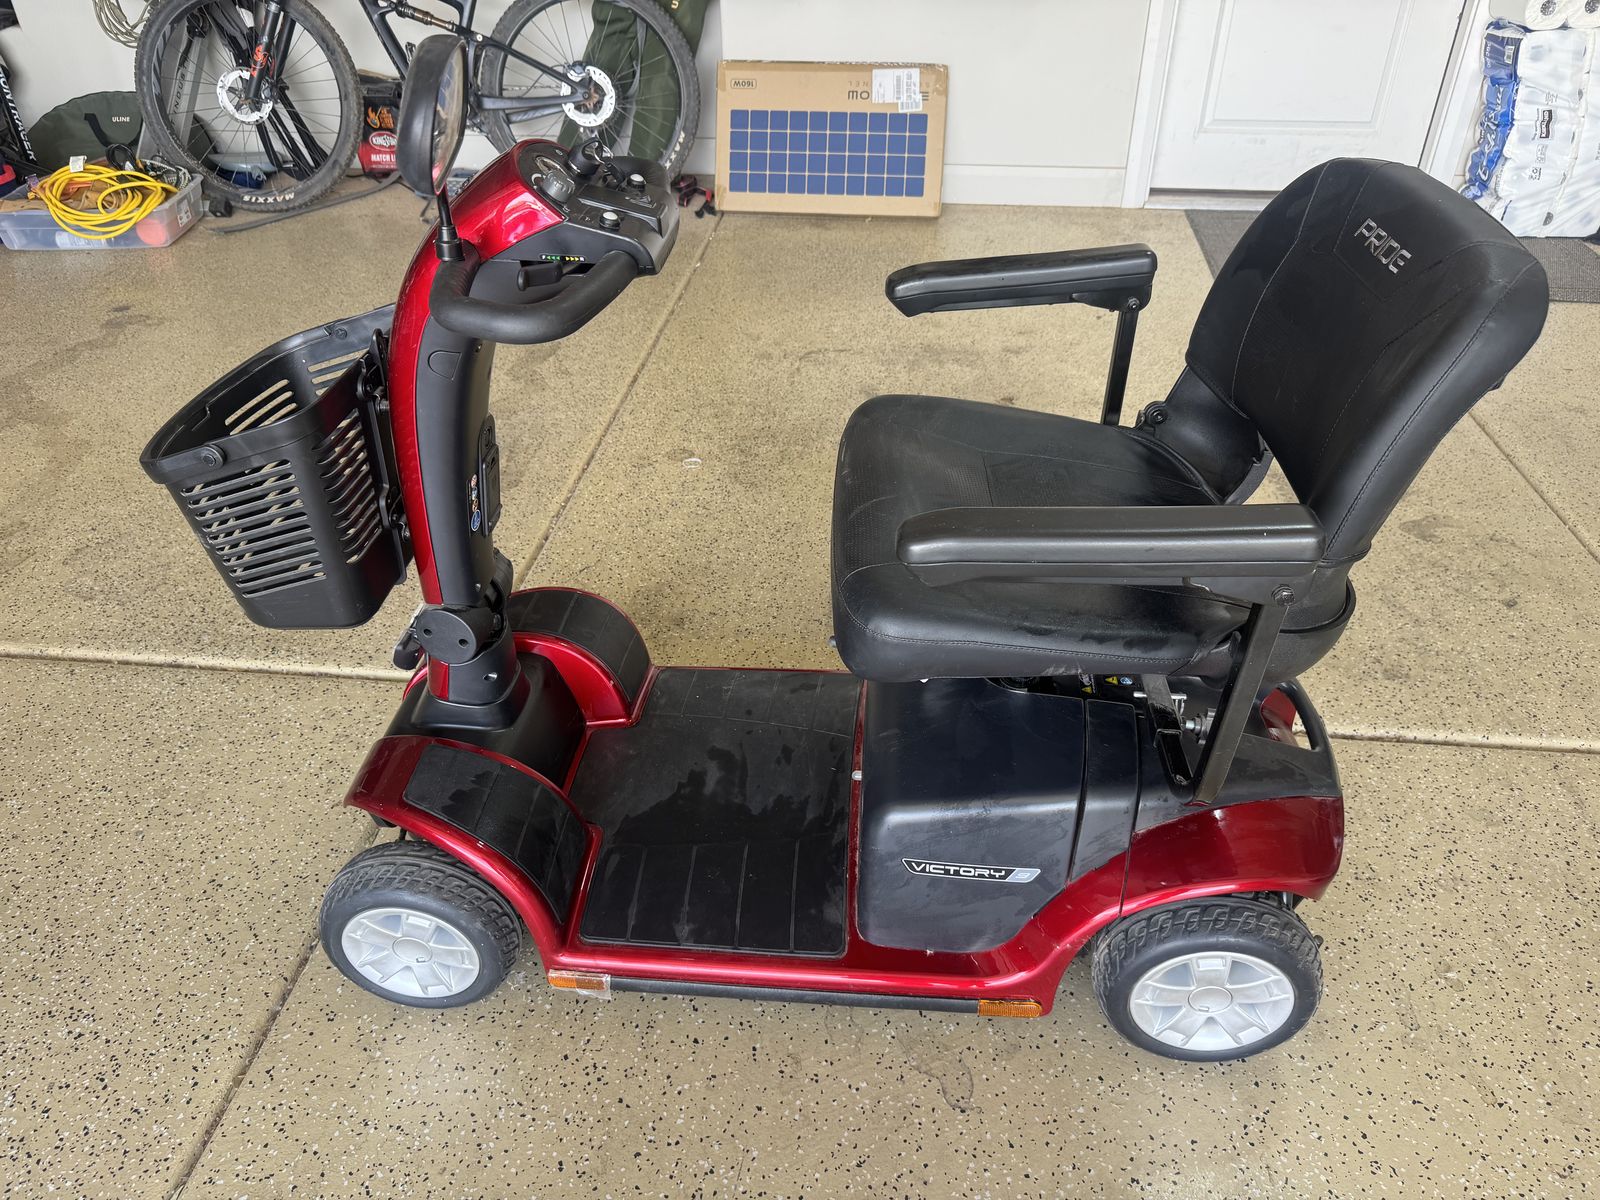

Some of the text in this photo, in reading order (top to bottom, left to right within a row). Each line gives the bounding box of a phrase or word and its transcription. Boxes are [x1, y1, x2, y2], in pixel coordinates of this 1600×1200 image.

[733, 80, 754, 88] 160W
[371, 153, 390, 162] MATCH
[243, 192, 295, 204] MAXXIS
[1354, 217, 1412, 274] PRIDE
[911, 862, 1006, 877] VICTORY
